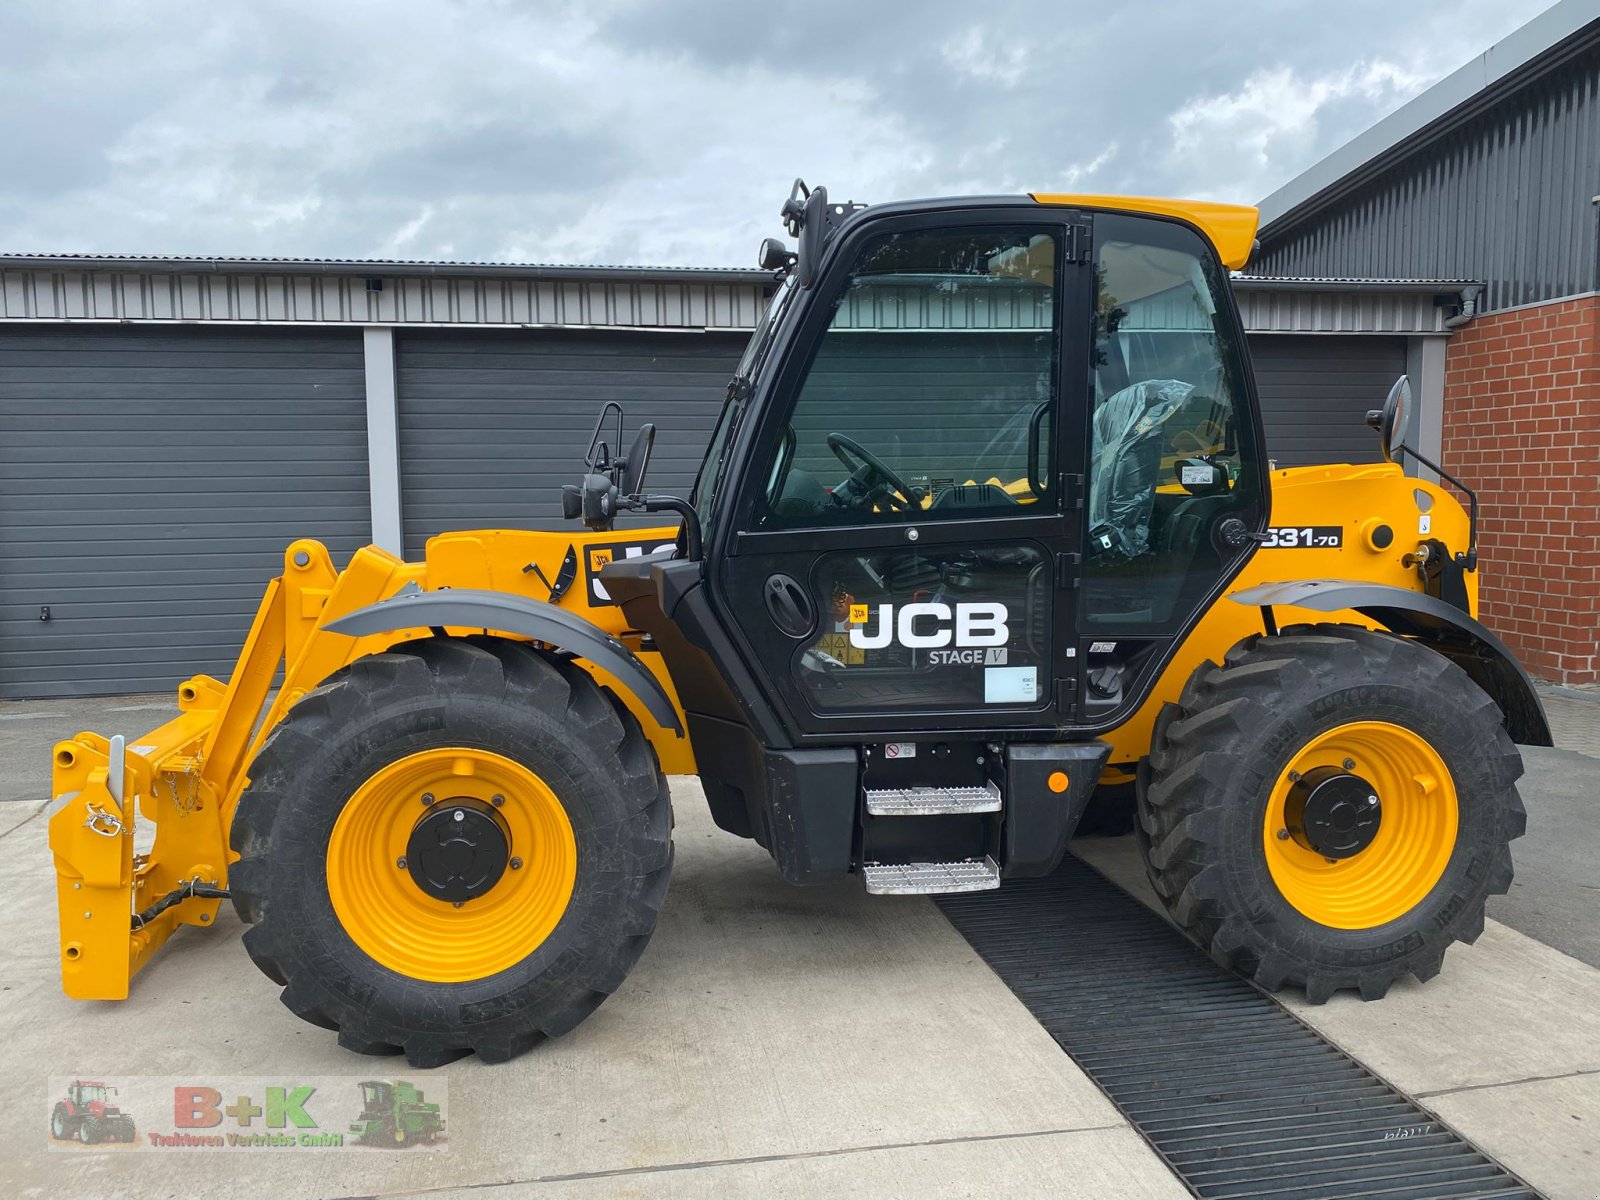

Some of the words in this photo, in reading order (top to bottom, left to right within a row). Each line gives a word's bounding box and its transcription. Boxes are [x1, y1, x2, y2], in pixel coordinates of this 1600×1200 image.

[849, 602, 1009, 649] JCB
[929, 650, 983, 664] STAGE
[993, 649, 1003, 662] V
